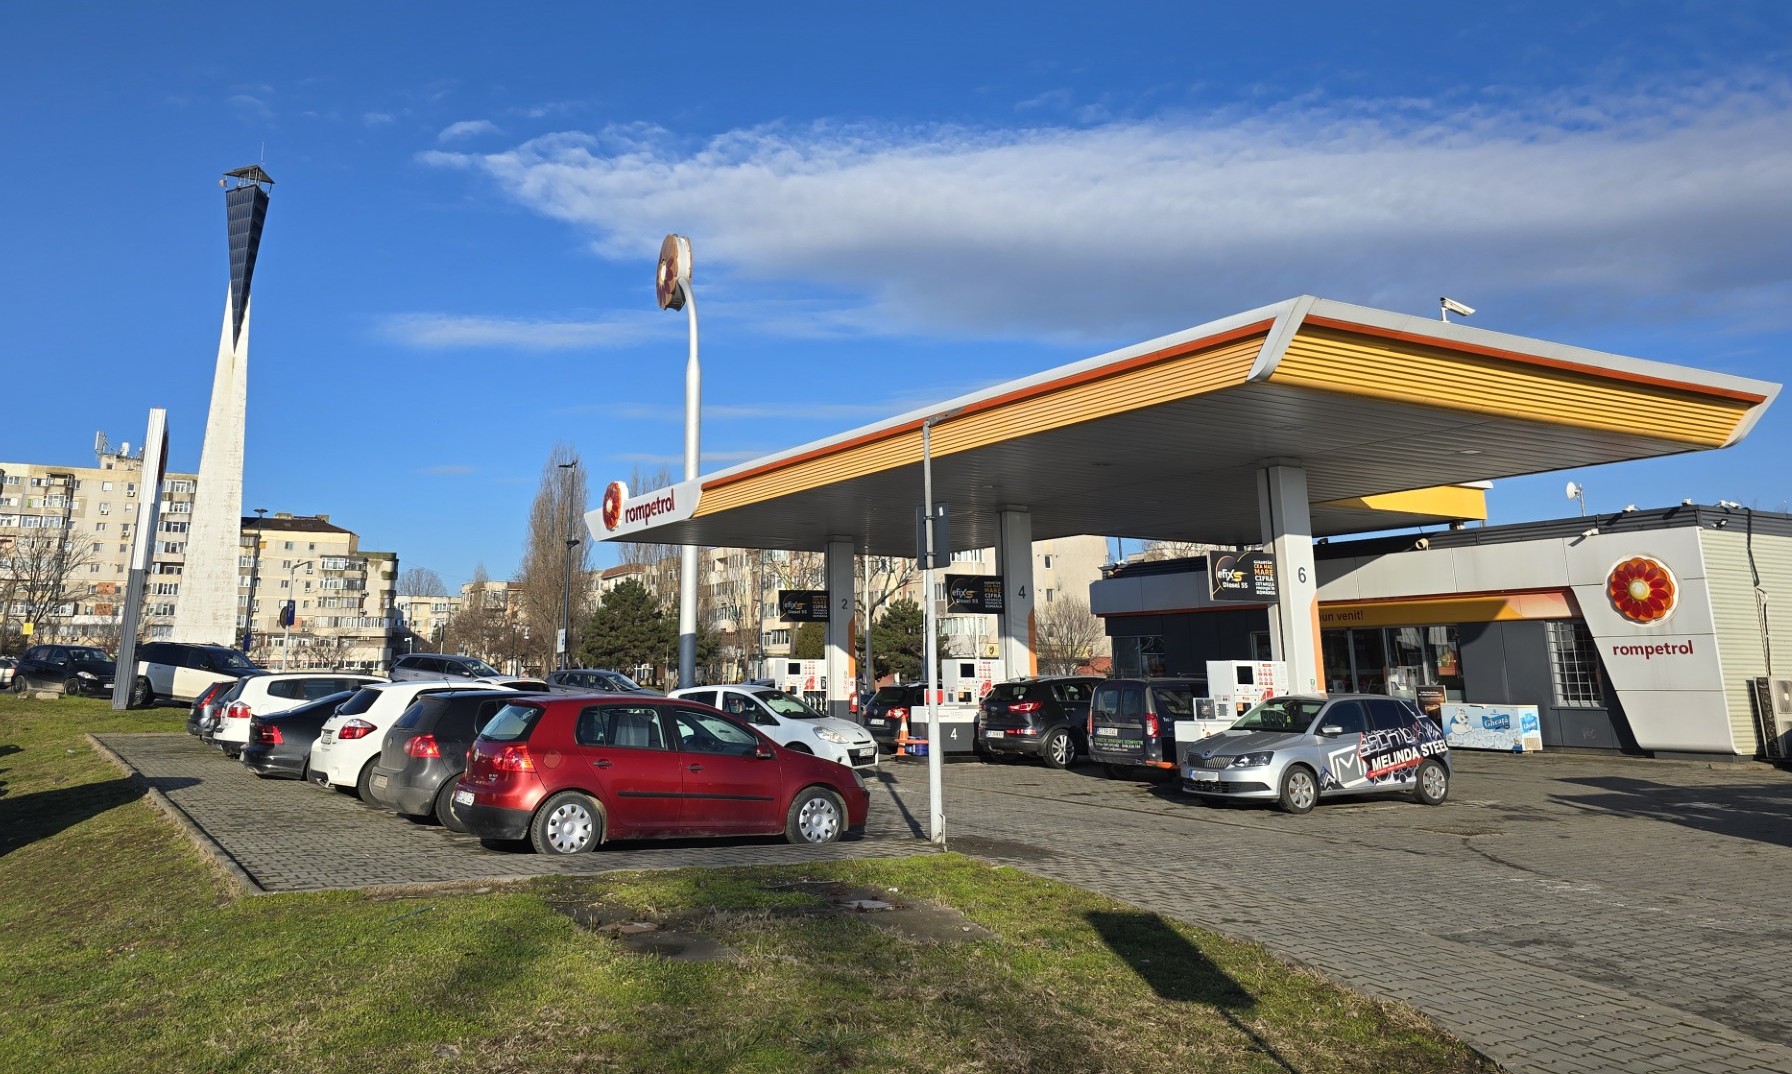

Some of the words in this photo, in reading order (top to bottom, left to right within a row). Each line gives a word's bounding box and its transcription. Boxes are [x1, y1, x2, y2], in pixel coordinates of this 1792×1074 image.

[625, 488, 675, 526] rompetrol
[1298, 566, 1306, 584] 6
[1018, 584, 1026, 599] 4
[287, 602, 294, 617] P
[841, 598, 848, 610] 2
[1337, 610, 1364, 621] venit!
[1612, 639, 1694, 660] rompetrol
[950, 727, 958, 740] 4
[1371, 746, 1421, 771] MELINDA
[1420, 739, 1449, 757] STEEL
